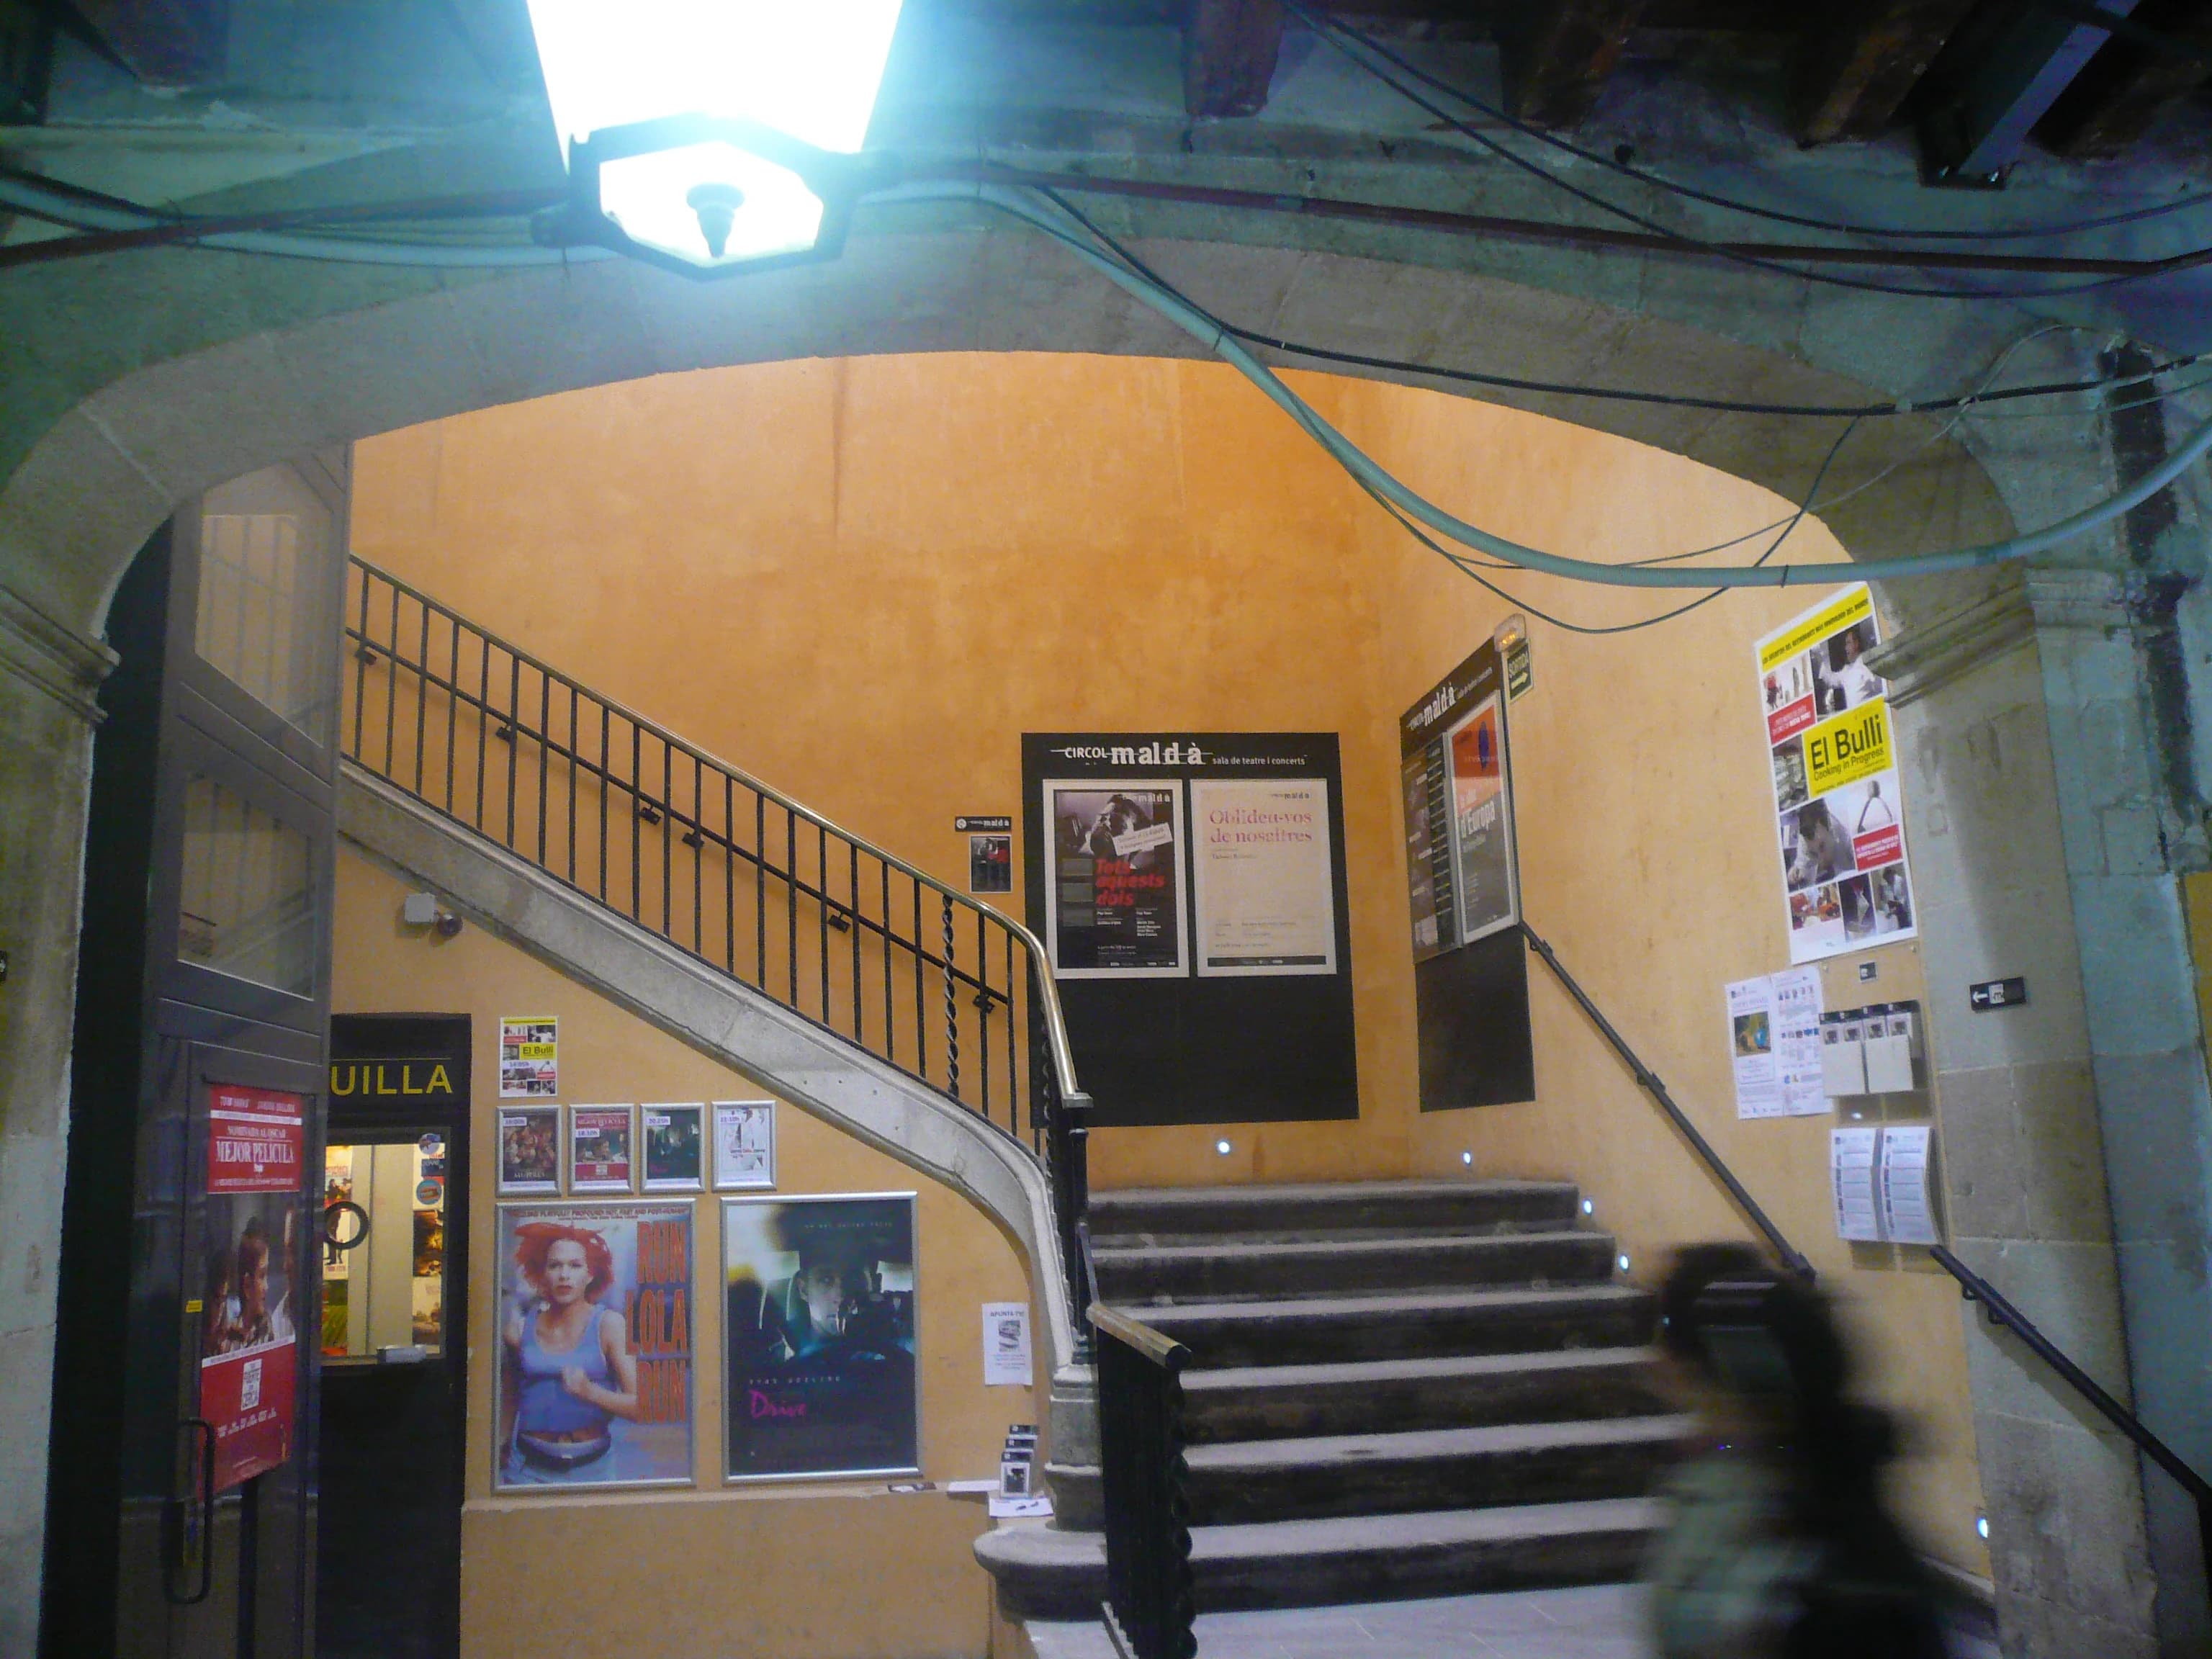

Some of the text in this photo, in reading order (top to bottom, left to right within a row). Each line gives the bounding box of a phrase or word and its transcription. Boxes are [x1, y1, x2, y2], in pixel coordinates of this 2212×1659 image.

[1064, 746, 1107, 759] CIRCOL
[1213, 757, 1229, 765] sala
[1230, 757, 1241, 765] de
[1242, 757, 1266, 765] teatre
[1272, 757, 1305, 765] concerts
[1810, 736, 1830, 771] El
[1834, 714, 1883, 760] Bulli
[1210, 828, 1231, 843] de
[523, 1045, 554, 1055] El Bulli
[215, 1141, 252, 1163] MEJOR
[636, 1220, 686, 1285] RUN
[624, 1288, 688, 1355] LOLA
[636, 1359, 687, 1424] RUN
